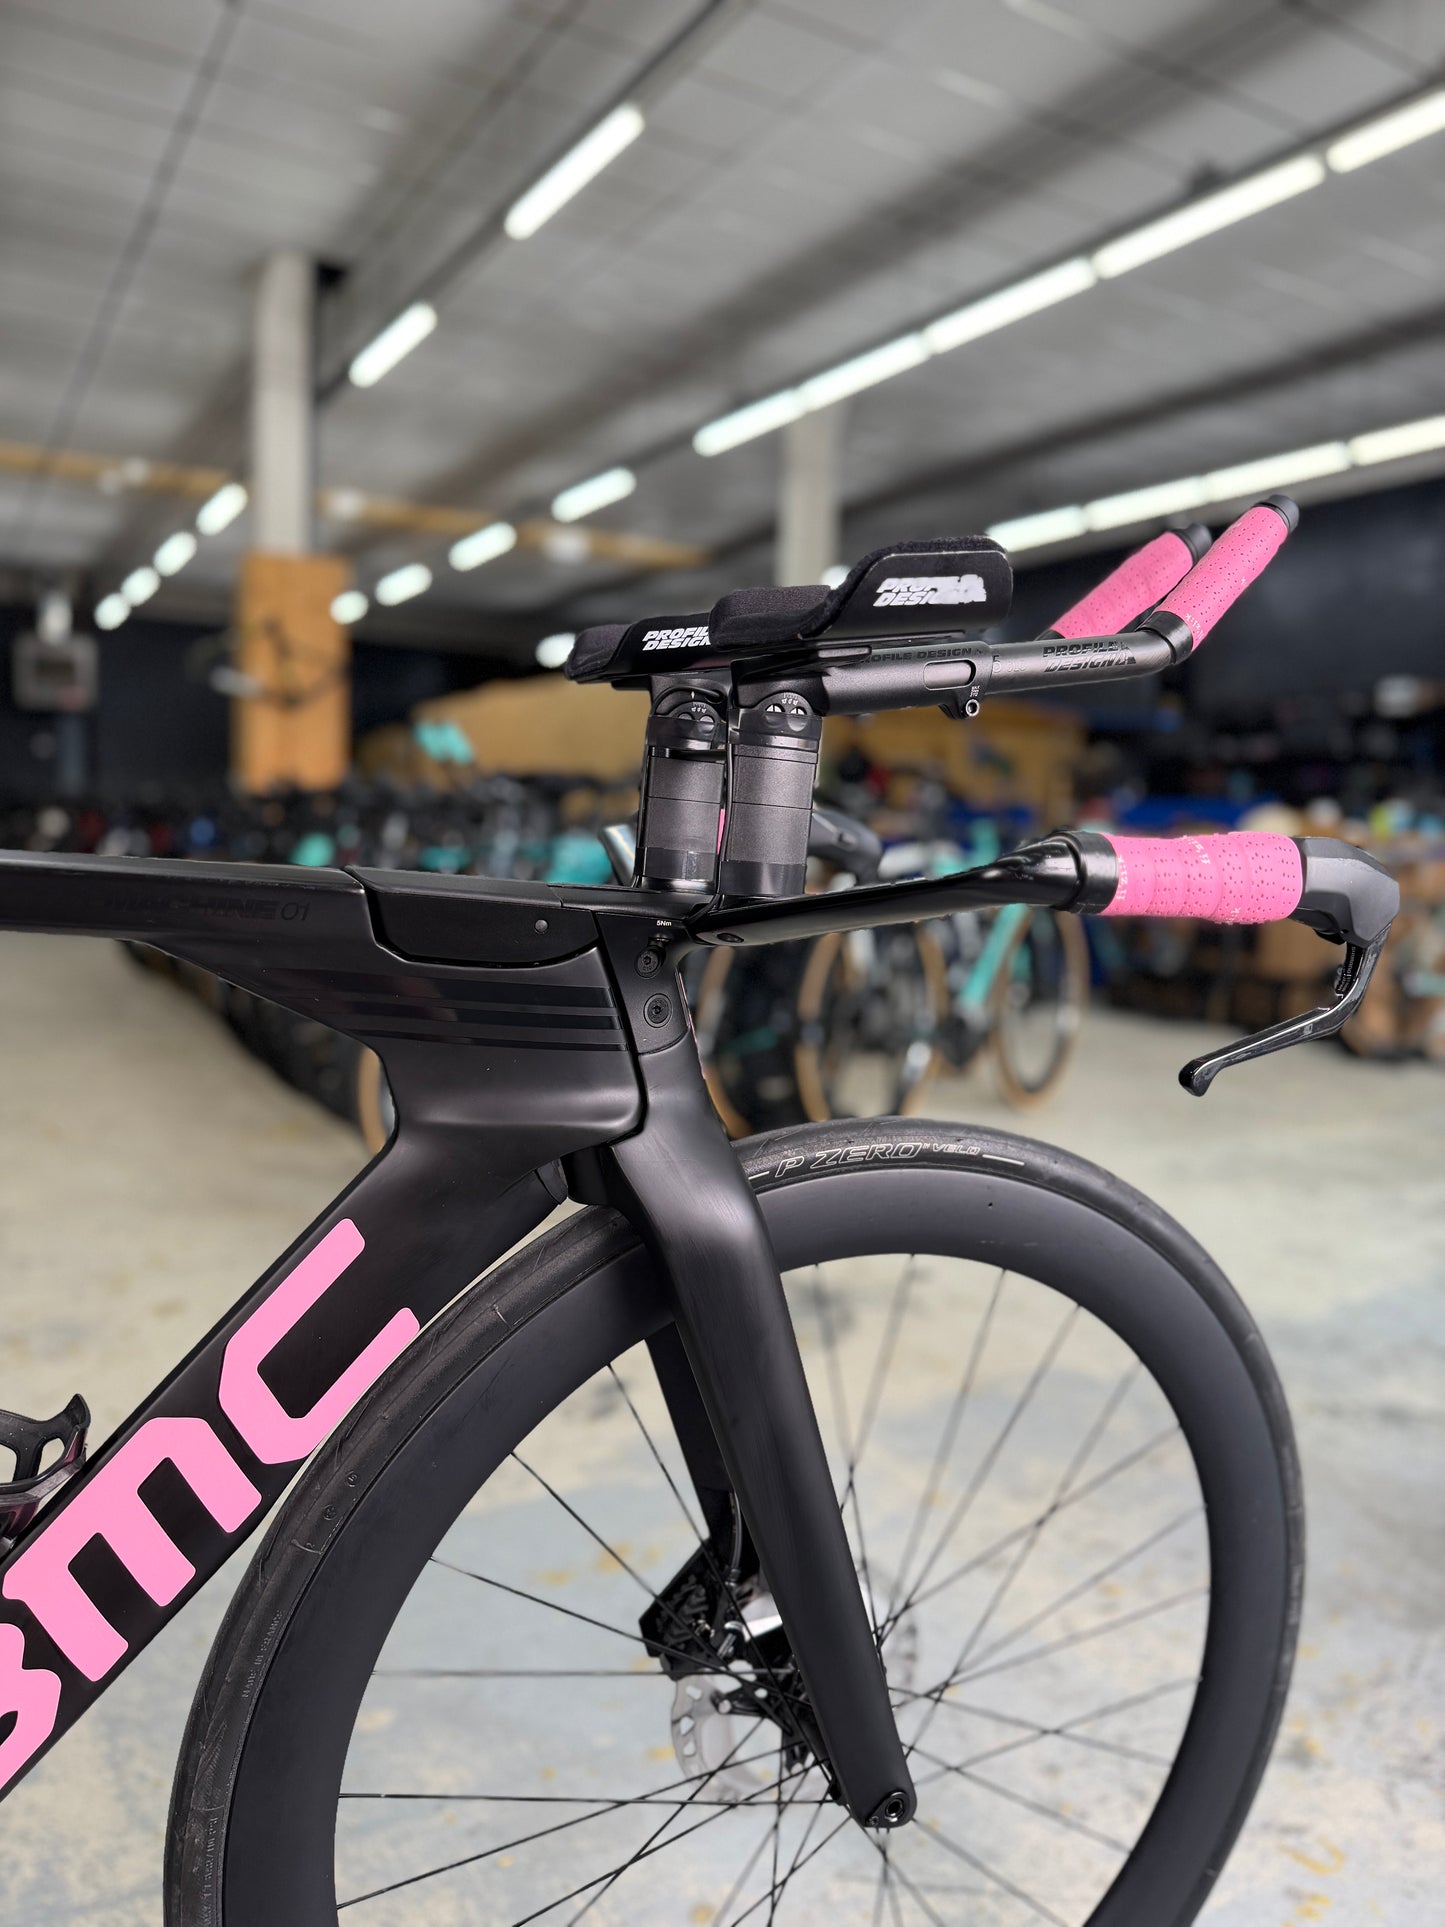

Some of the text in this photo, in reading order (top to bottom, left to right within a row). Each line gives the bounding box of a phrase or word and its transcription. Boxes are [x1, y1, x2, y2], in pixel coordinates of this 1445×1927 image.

[642, 626, 709, 642] PROFIL
[916, 647, 972, 659] DESIGN
[1043, 641, 1119, 658] PROFILE
[1044, 653, 1116, 673] DESIGN
[775, 1156, 805, 1178] P
[933, 1143, 981, 1155] VELO
